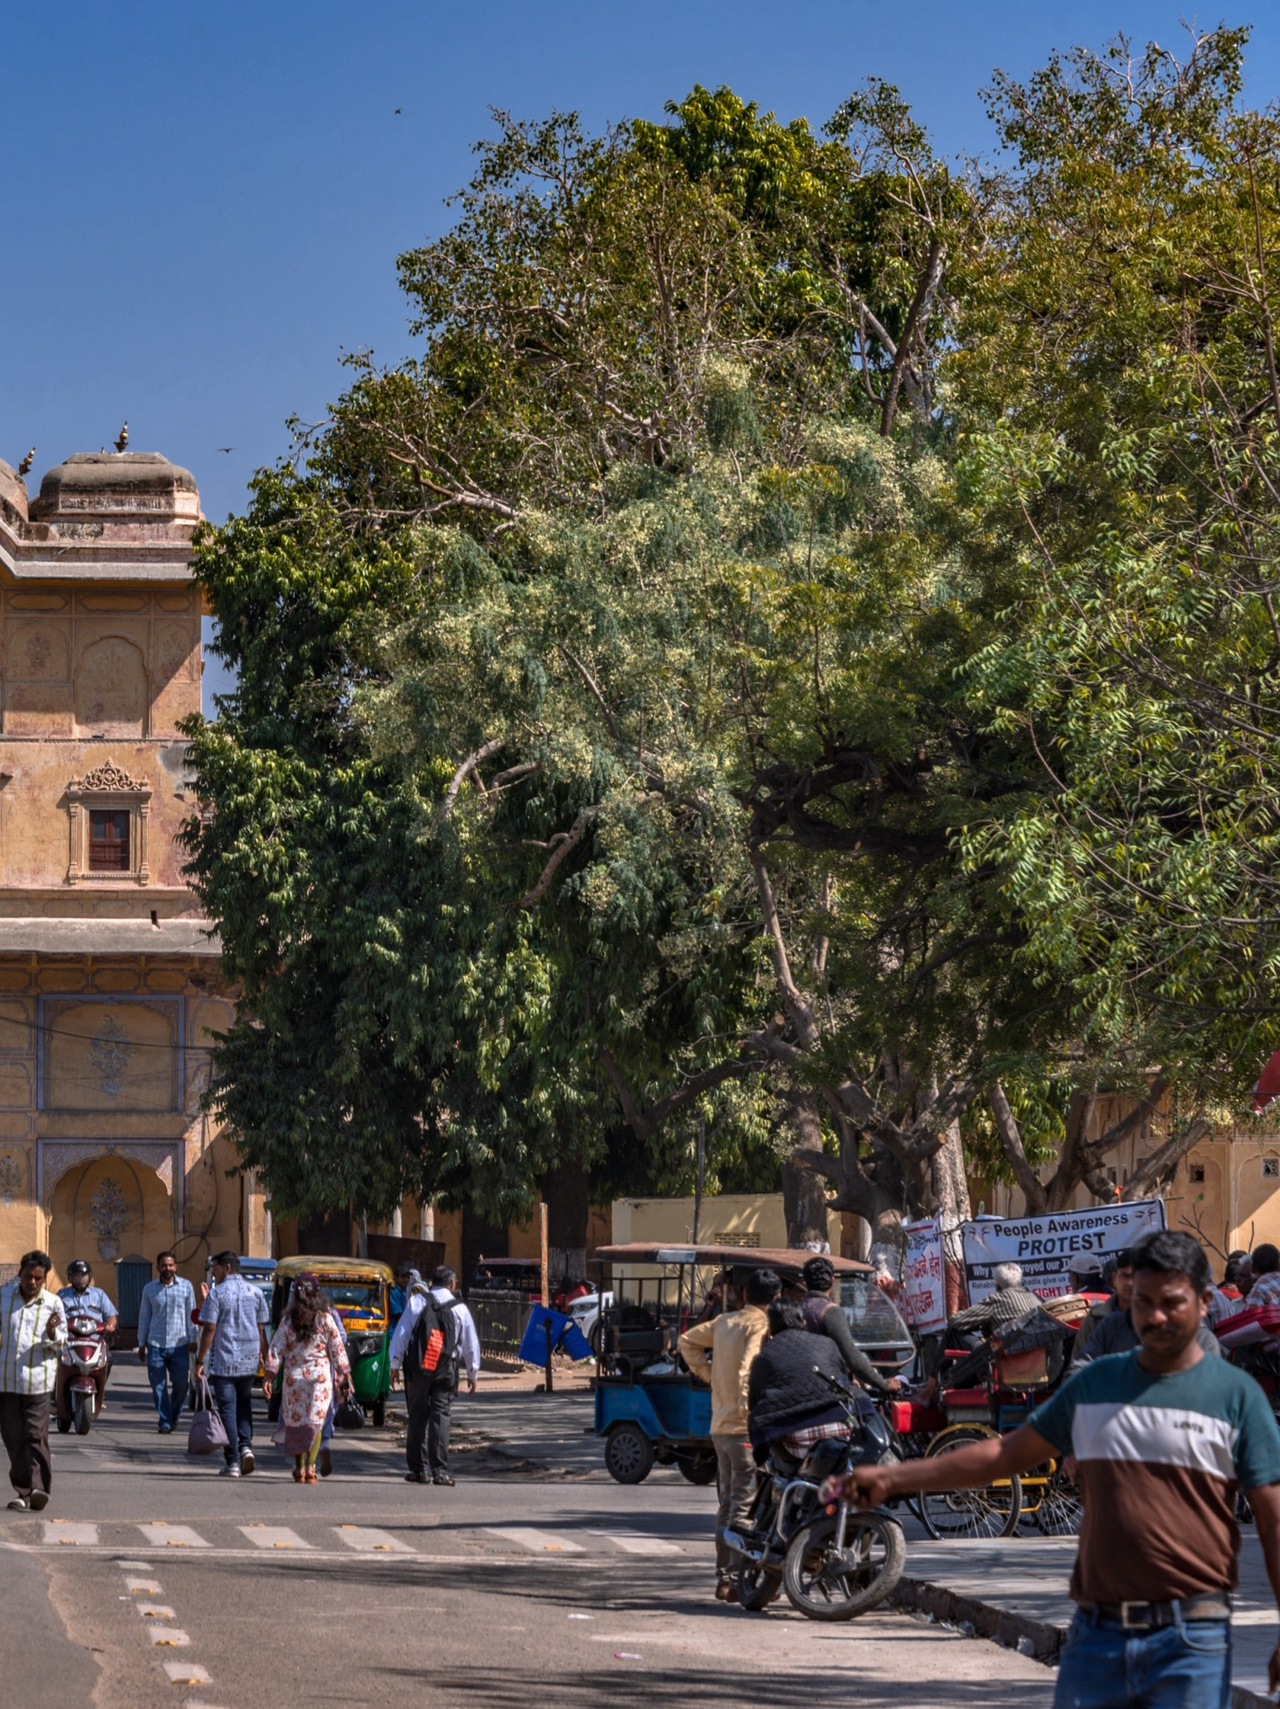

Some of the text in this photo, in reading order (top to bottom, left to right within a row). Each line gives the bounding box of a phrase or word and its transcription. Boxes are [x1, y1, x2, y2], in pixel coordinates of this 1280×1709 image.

[993, 1213, 1128, 1239] People Awareness
[1018, 1232, 1106, 1257] PROTEST
[972, 1265, 990, 1279] Why
[1046, 1261, 1060, 1270] our
[1042, 1276, 1056, 1286] give
[1032, 1286, 1062, 1298] FIGHT
